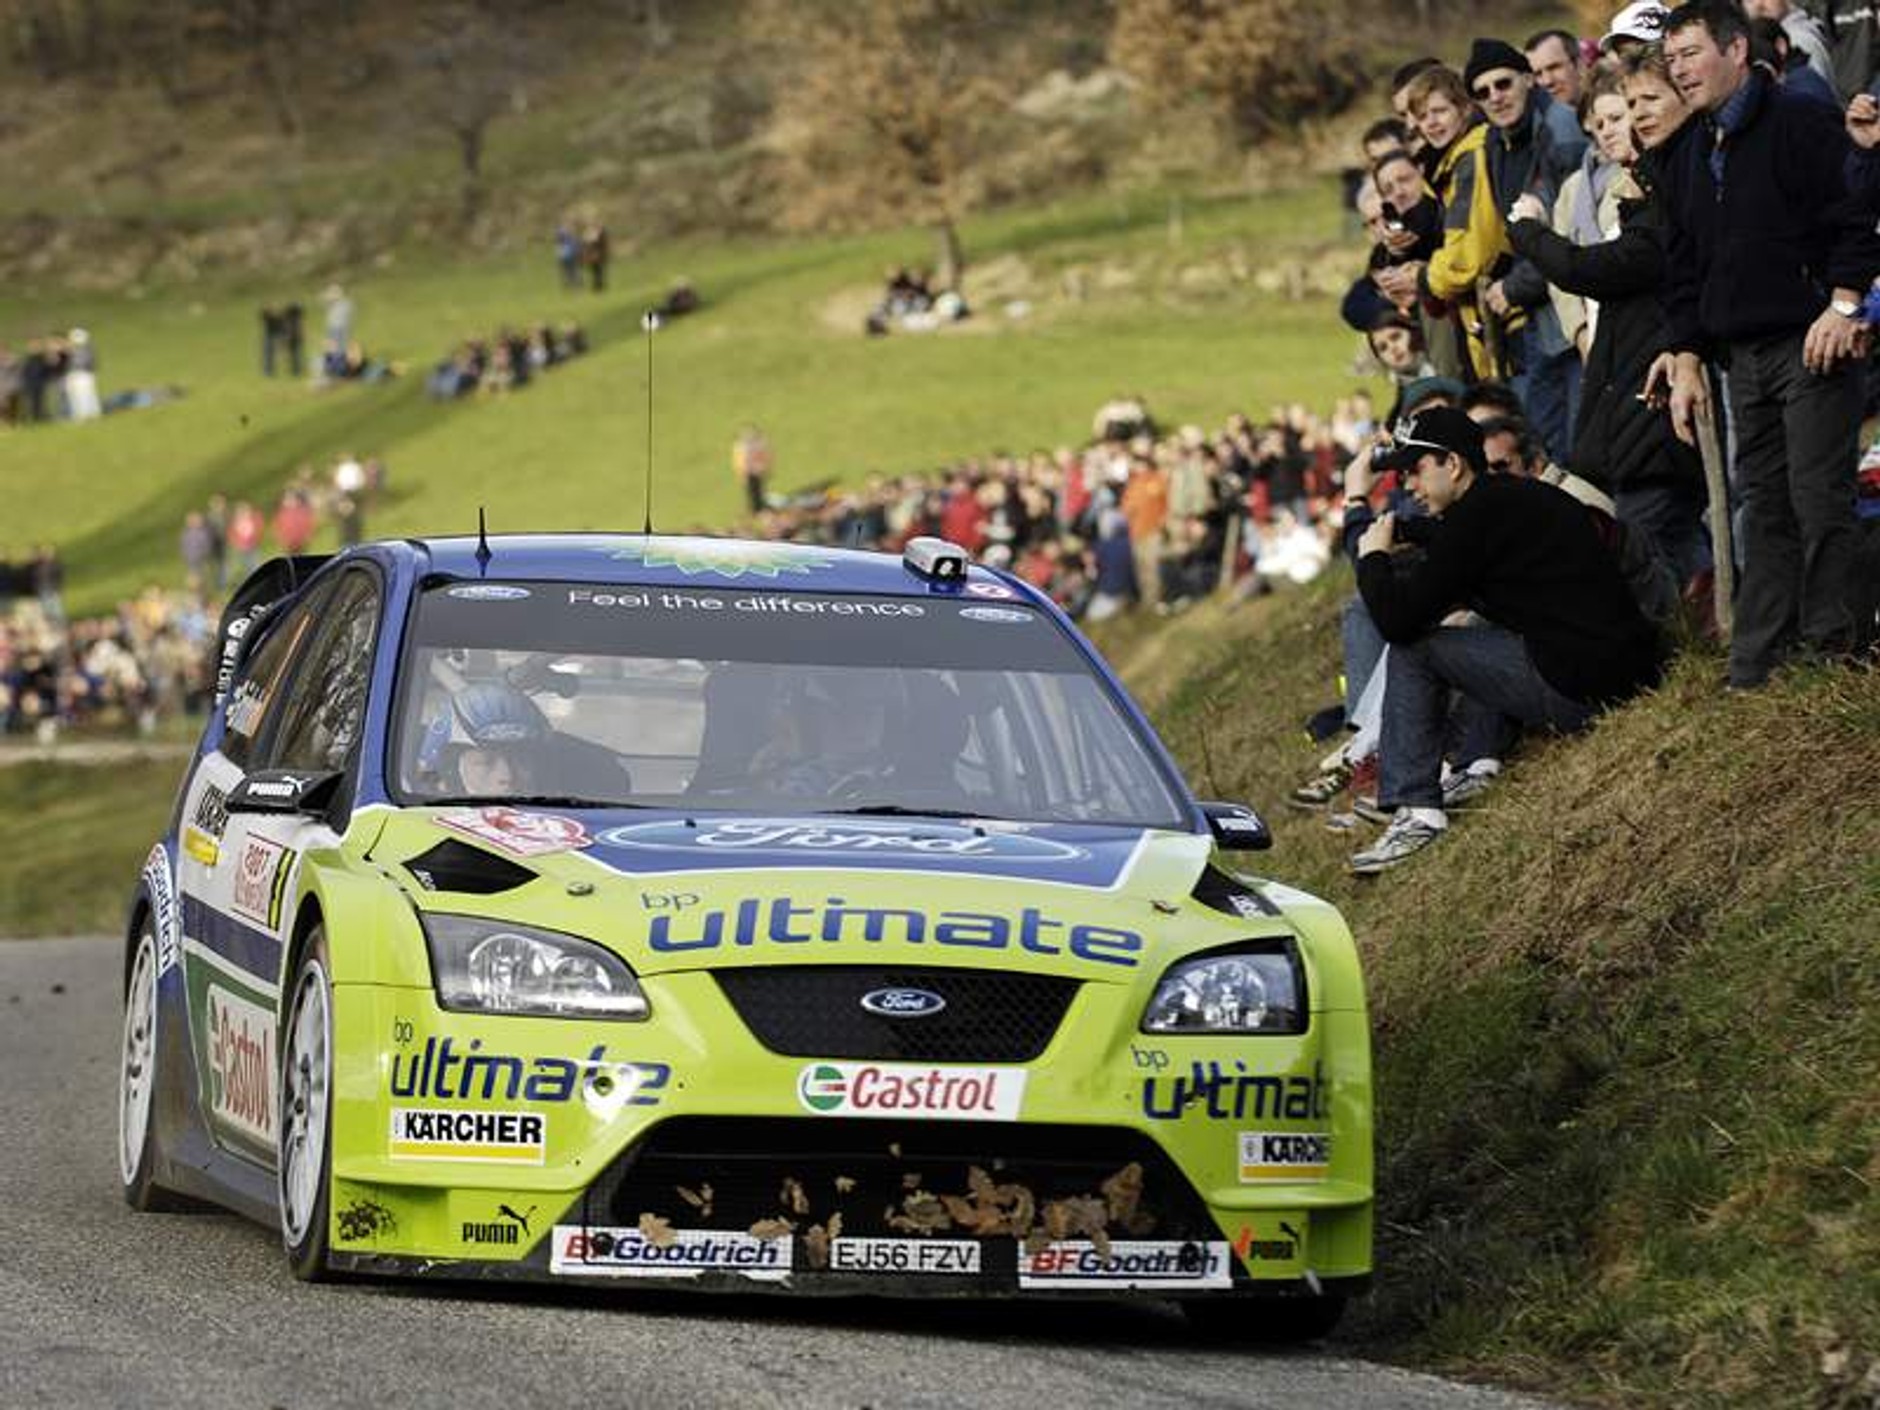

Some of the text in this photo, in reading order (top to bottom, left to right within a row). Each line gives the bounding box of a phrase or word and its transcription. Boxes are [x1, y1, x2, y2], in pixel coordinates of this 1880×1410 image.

[568, 590, 925, 616] Feel the difference
[695, 823, 993, 853] Ford
[641, 892, 699, 910] bp
[648, 896, 1143, 967] ultimate
[881, 991, 926, 1010] Ford
[393, 1016, 414, 1047] bp
[1130, 1043, 1170, 1073] bp
[851, 1067, 998, 1111] Castrol
[404, 1111, 543, 1144] KÄRCHER
[462, 1222, 519, 1245] PUMA
[564, 1233, 779, 1264] BGoodrich
[836, 1242, 976, 1270] EJ56 FZV
